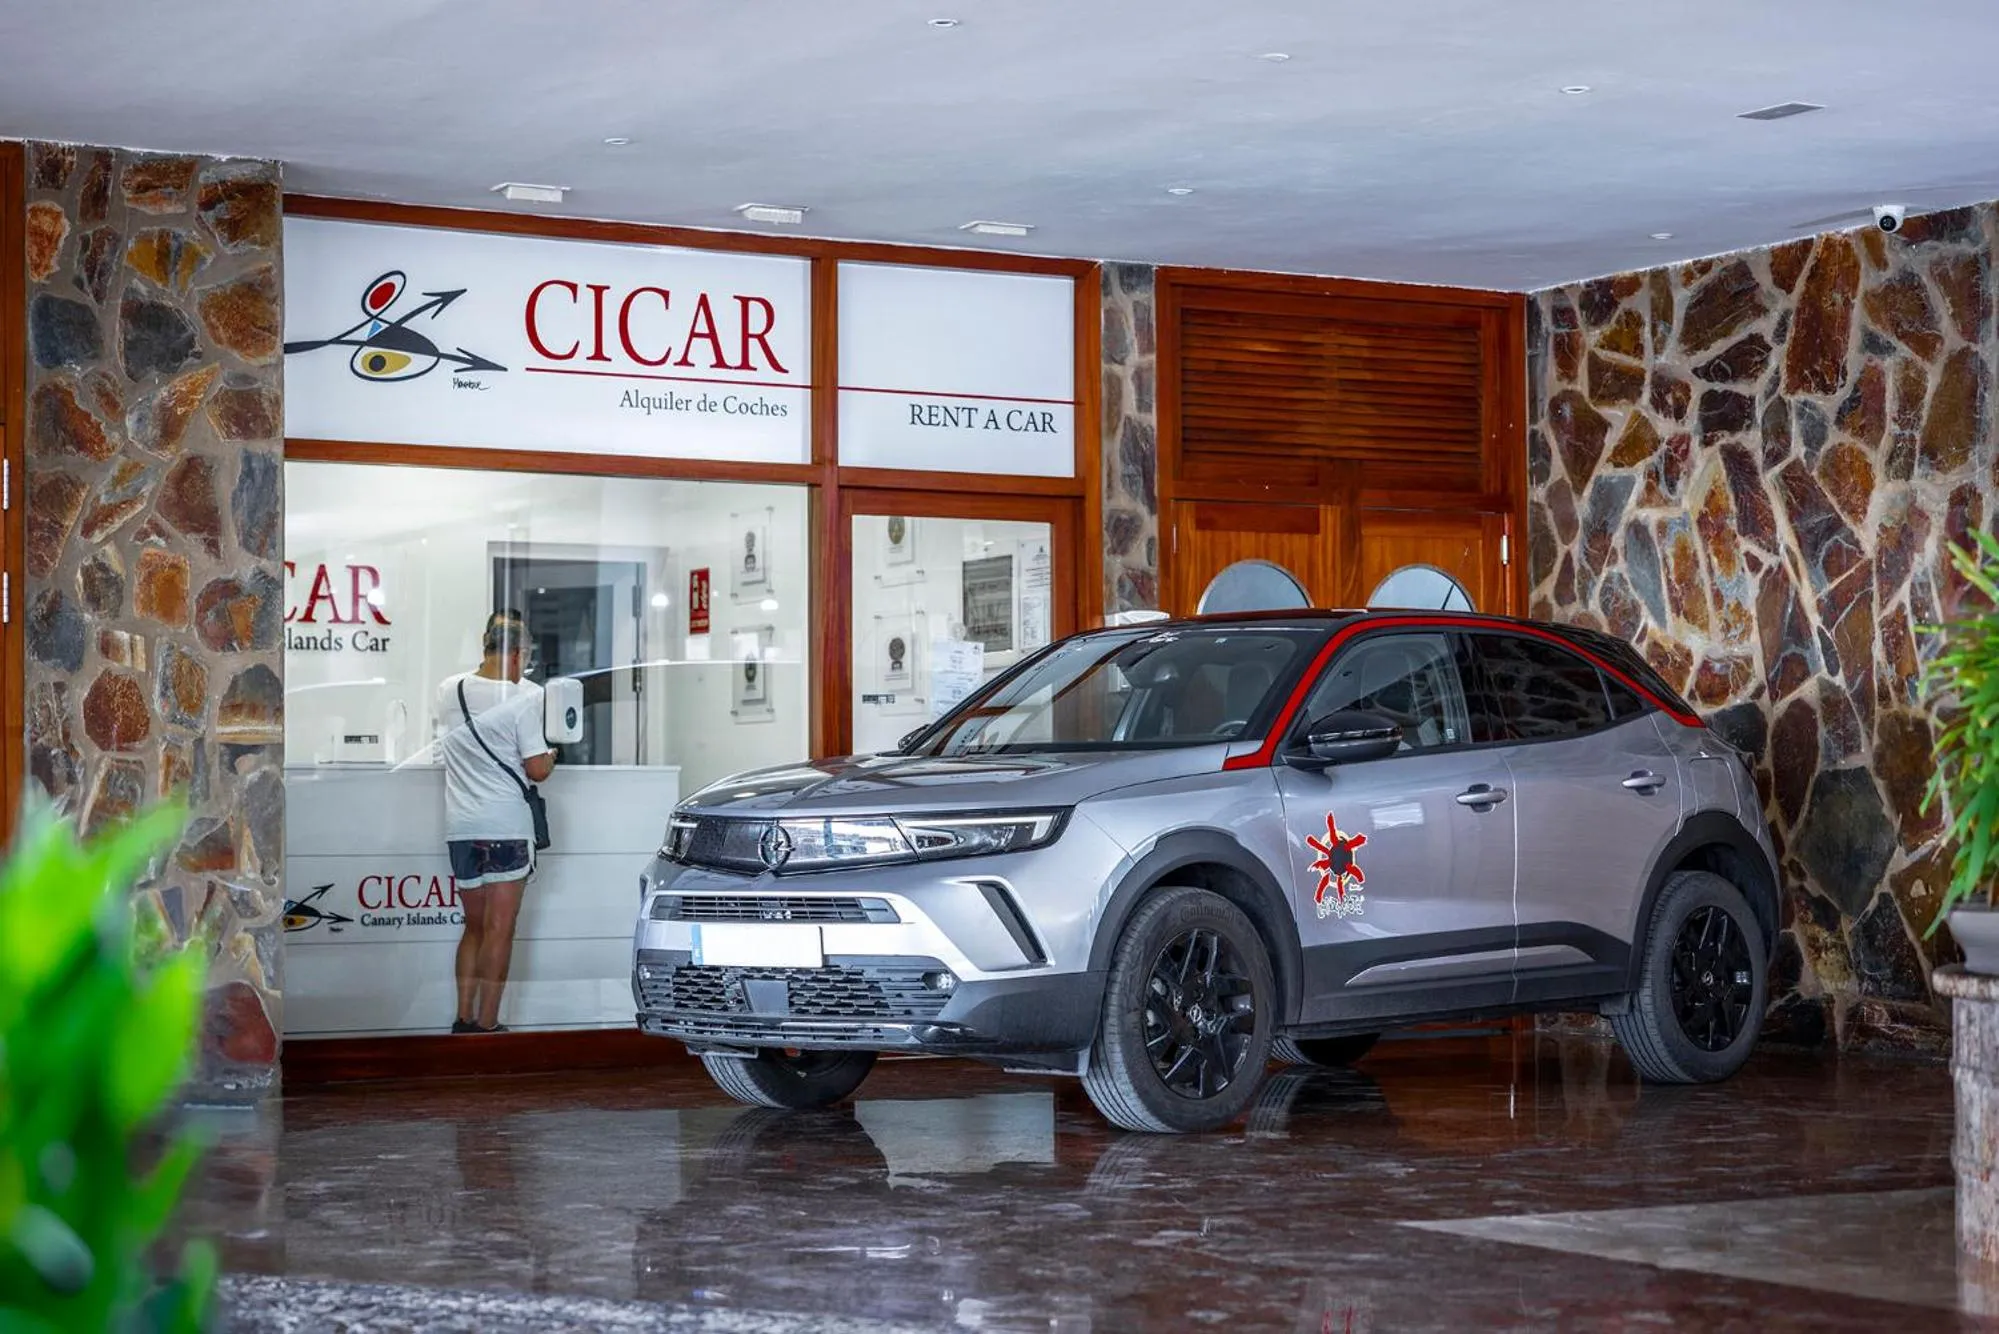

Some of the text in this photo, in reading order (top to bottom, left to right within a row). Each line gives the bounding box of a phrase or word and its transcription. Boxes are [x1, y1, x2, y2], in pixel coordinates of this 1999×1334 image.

[525, 279, 789, 374] CICAR
[619, 389, 788, 417] Alquiler de Coches
[909, 403, 1058, 434] RENT A CAR
[351, 630, 391, 652] Car
[360, 912, 404, 929] Canary
[406, 912, 447, 926] Islands
